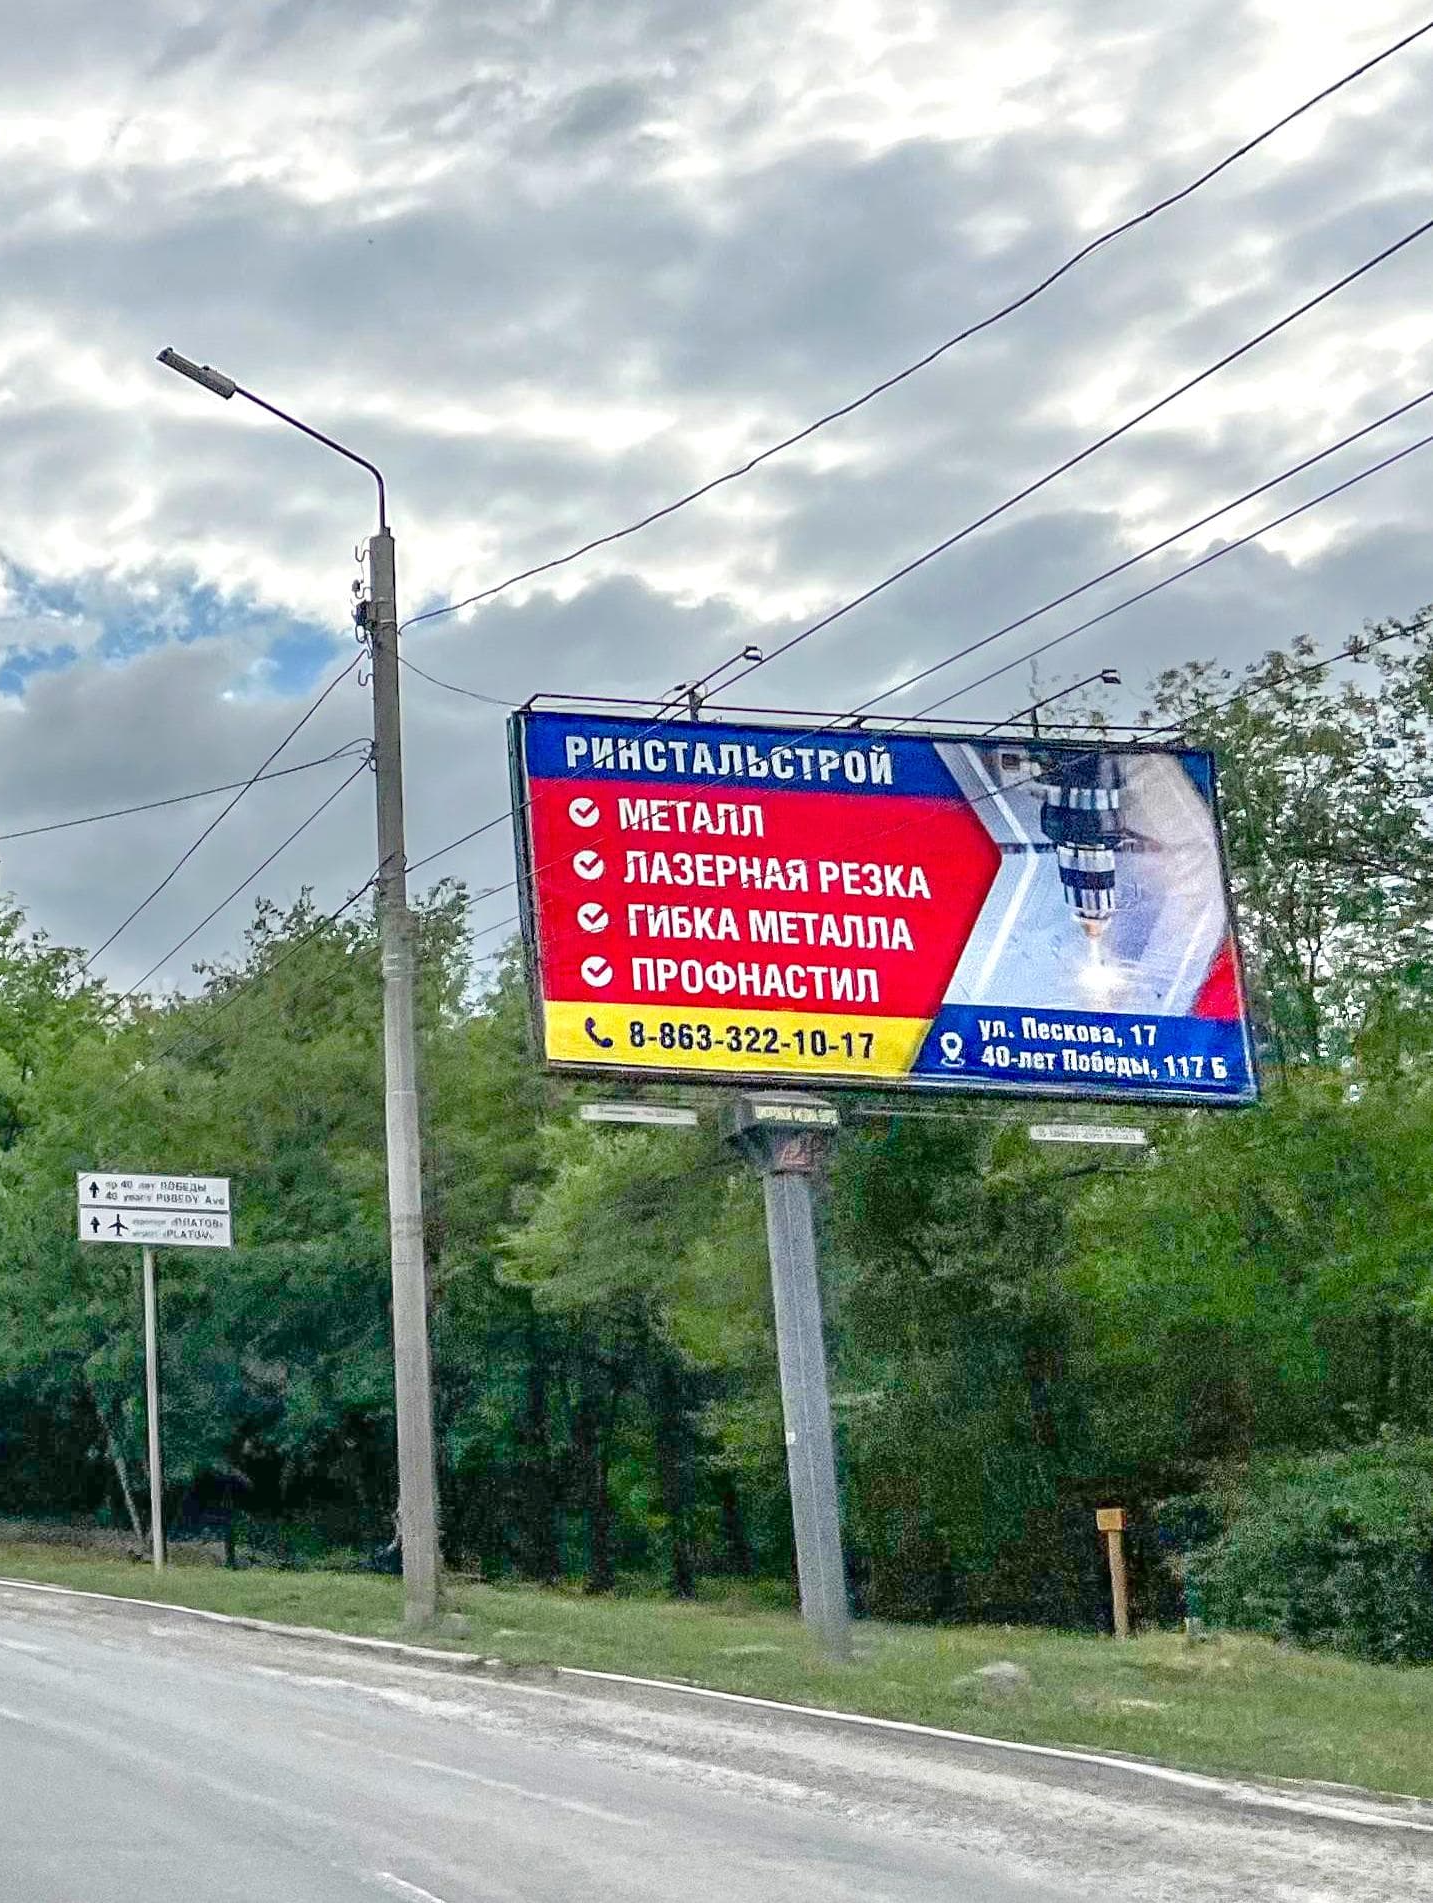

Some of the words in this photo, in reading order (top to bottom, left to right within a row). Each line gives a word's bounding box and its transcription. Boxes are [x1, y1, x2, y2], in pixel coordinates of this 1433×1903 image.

[565, 735, 894, 785] РИНСТАЛЬСТРОЙ
[618, 797, 765, 838] МЕТАЛЛ
[623, 850, 809, 892] ЛАЗЕРНАЯ
[819, 860, 931, 899] РЕЗКА
[628, 904, 740, 941] ГИБКА
[748, 910, 915, 951] МЕТАЛЛА
[631, 957, 880, 1003] ПРОФНАСТИЛ
[629, 1020, 875, 1058] 8-863-322-10-17
[978, 1018, 1015, 1041] ул.
[1021, 1016, 1125, 1047] Пескова,
[1130, 1024, 1158, 1047] 17
[980, 1044, 1056, 1072] 40-лет
[1061, 1049, 1158, 1080] Победы,
[1163, 1055, 1204, 1079] 117
[1211, 1057, 1228, 1079] Б
[160, 1181, 207, 1193] ПОБЕДЫ
